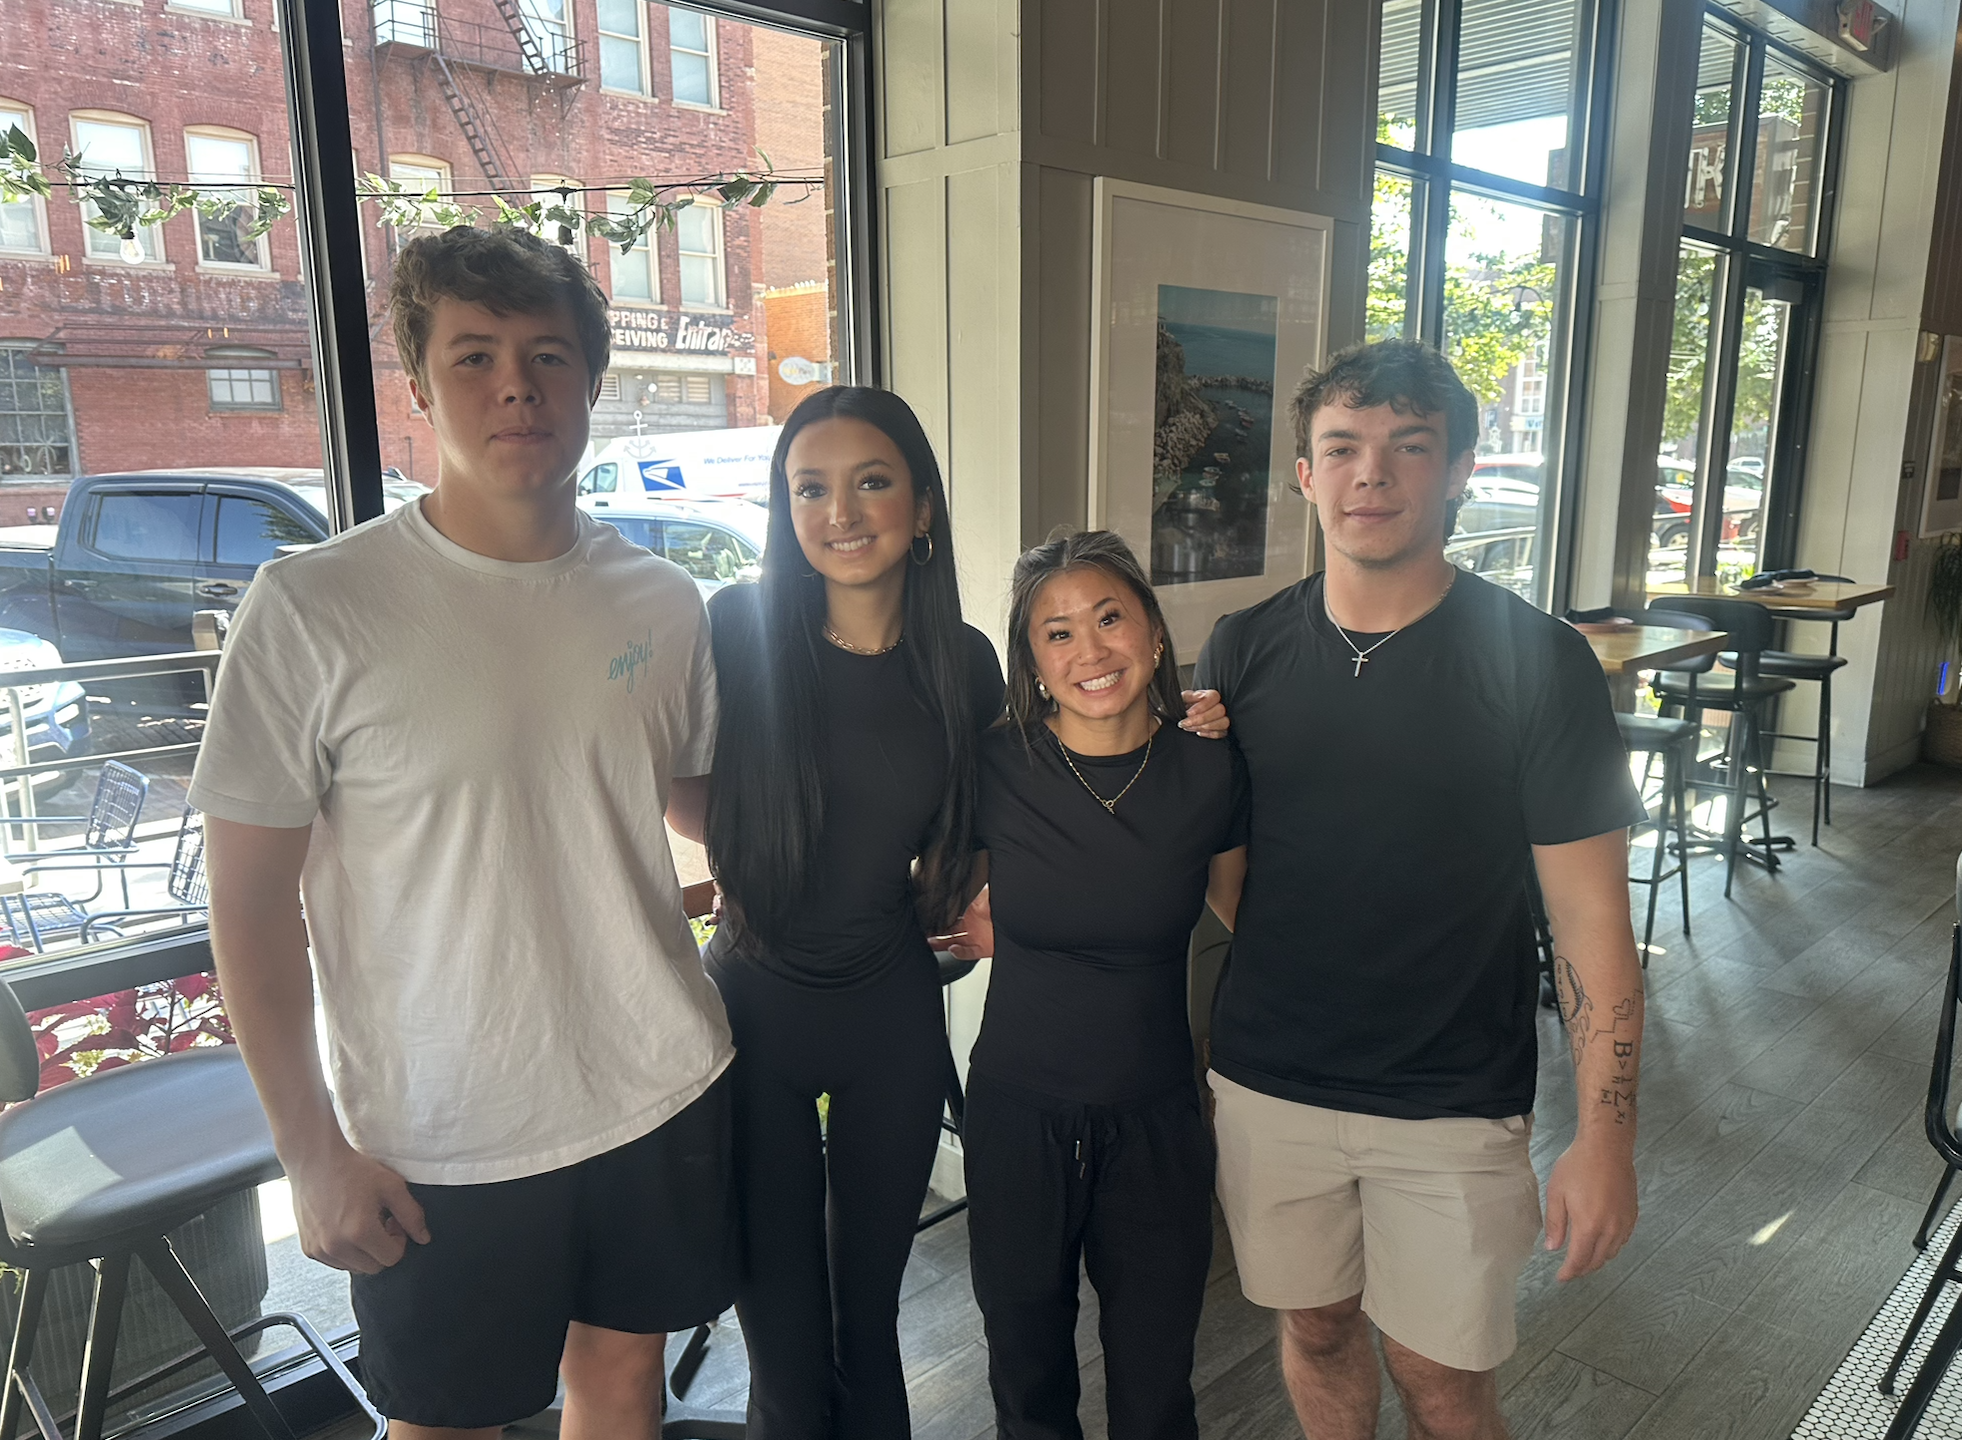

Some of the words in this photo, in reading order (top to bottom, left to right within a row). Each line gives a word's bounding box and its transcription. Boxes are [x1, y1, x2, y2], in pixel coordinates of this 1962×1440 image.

[608, 310, 659, 329] PPING
[717, 456, 742, 464] Deliver
[744, 454, 756, 462] For
[607, 628, 653, 694] enjoy!
[1613, 1039, 1633, 1058] B
